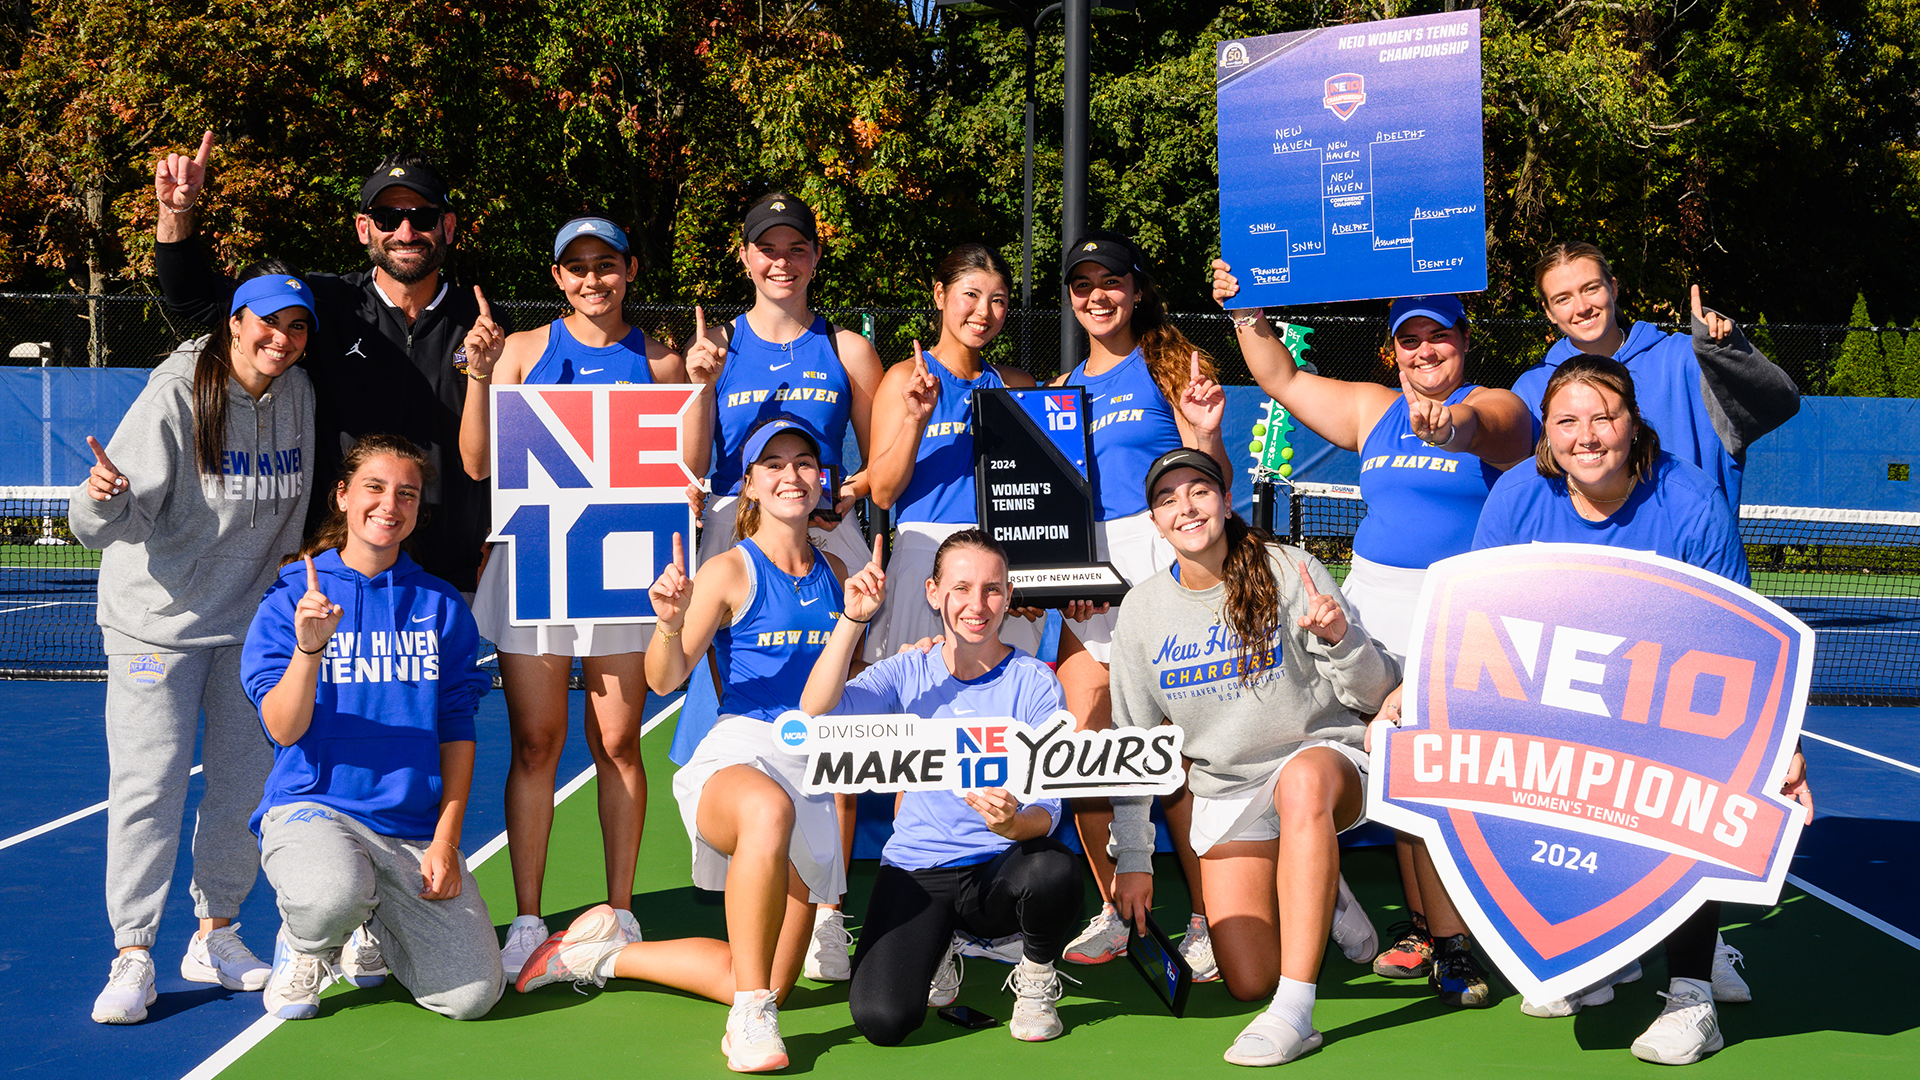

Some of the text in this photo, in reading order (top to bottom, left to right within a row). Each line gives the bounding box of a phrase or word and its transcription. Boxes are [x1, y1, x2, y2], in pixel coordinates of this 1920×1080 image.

[1338, 22, 1469, 50] NE10 WOMEN'S TENNIS
[1228, 51, 1240, 61] 50
[1379, 40, 1470, 63] CHAMPIONSHIP
[1330, 80, 1360, 93] NE10
[1275, 125, 1302, 140] NEW
[1376, 130, 1426, 142] ADELPHI
[1272, 139, 1312, 154] HAVEN
[1327, 141, 1348, 151] NEW
[1326, 150, 1360, 161] HAVEN
[1330, 169, 1354, 183] NEW
[1327, 182, 1363, 195] HAVEN
[1414, 205, 1477, 218] ASSUMPTION
[1249, 223, 1276, 233] SNHU
[1332, 222, 1369, 234] ADELPHI
[1292, 241, 1321, 253] SNHU
[1417, 257, 1463, 270] BENTLEY
[1288, 328, 1301, 343] SET
[803, 371, 827, 380] NE10
[727, 388, 839, 408] NEW HAVEN
[1045, 395, 1077, 411] NE
[1110, 393, 1134, 405] NE10
[1047, 412, 1077, 431] 10
[1089, 409, 1145, 435] HAVEN
[1272, 410, 1285, 427] 2
[926, 421, 967, 438] NEW
[1272, 426, 1279, 441] 1
[496, 390, 694, 490] NE
[1267, 441, 1277, 467] HOME
[990, 460, 1017, 469] 2024
[1361, 455, 1459, 474] NEW HAVEN
[201, 472, 303, 501] TENNIS
[991, 483, 1051, 496] WOMEN'S
[992, 498, 1035, 511] TENNIS
[994, 525, 1069, 541] CHAMPION
[498, 502, 690, 620] 10
[1010, 575, 1035, 583] RSITY
[1050, 574, 1071, 582] NEW
[1072, 573, 1102, 581] HAVEN
[326, 629, 439, 658] EW HAVEN
[757, 630, 802, 646] NEW
[1152, 633, 1201, 665] New
[320, 655, 440, 684] TENNIS
[1166, 652, 1274, 686] CHARGERS
[1453, 609, 1756, 740] NE10
[1166, 692, 1187, 700] WEST
[1190, 686, 1217, 698] HAVEN
[1218, 691, 1244, 701] U.S.A.
[783, 732, 808, 740] NCAA
[818, 723, 914, 739] DIVISION II
[956, 726, 1009, 753] NE
[812, 749, 947, 785] MAKE
[957, 756, 1008, 788] 10
[1413, 733, 1758, 848] CHAMPIONS
[1512, 791, 1640, 829] WOMEN'S TENNIS
[1531, 839, 1599, 874] 2024
